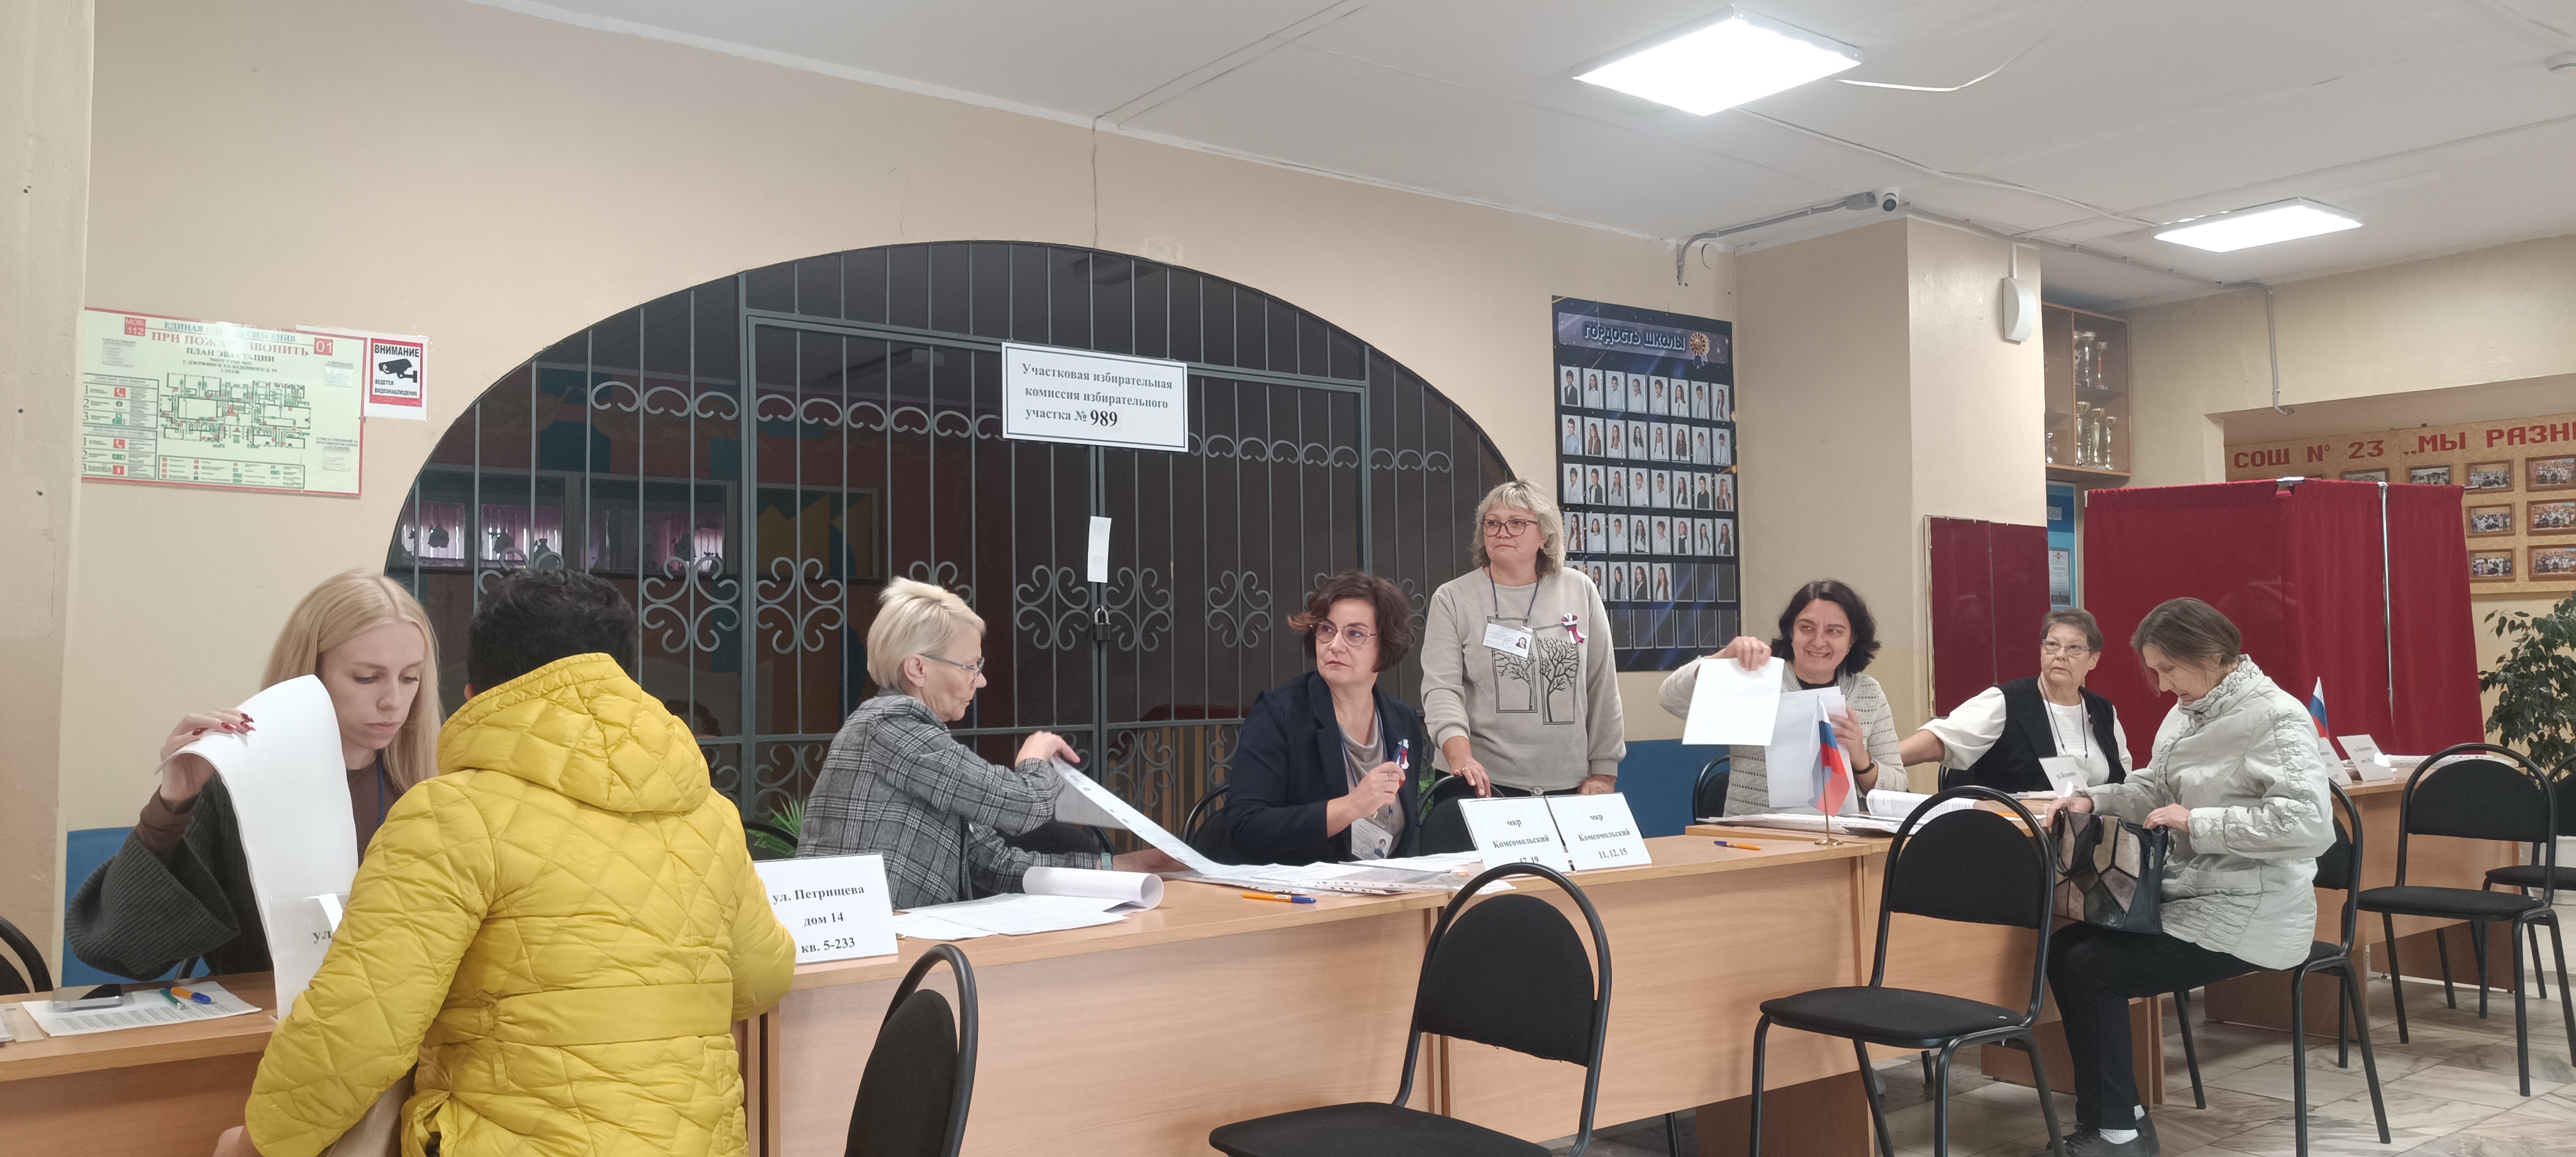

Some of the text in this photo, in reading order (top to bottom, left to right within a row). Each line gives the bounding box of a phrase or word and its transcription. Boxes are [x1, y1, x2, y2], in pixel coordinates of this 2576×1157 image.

[126, 318, 144, 326] МОБ
[128, 326, 144, 335] 112
[164, 321, 203, 333] ЕДИНАЯ
[247, 331, 296, 342] СПАСЕНИЯ
[1584, 324, 1685, 350] ГОРДОСТЬ ШКОЛЫ
[152, 332, 180, 343] ПРИ
[249, 341, 309, 356] ЗВОНИТЬ
[316, 340, 332, 353] 01
[374, 344, 419, 357] ВНИМАНИЕ
[186, 347, 214, 357] ПЛАН
[1021, 363, 1172, 389] Участковая избирательная
[374, 388, 418, 396] ВИДЕОНАБЛЮДЕНИЕ
[1025, 387, 1169, 409] комиссия избирательного
[1025, 408, 1118, 427] участка № 989
[2234, 448, 2290, 468] СОШ
[2348, 440, 2384, 459] 23
[1507, 819, 1521, 827] мкр
[1590, 813, 1603, 822] мкр
[1492, 834, 1550, 849] Комсомольский
[1577, 828, 1631, 842] Комсомольский
[1620, 848, 1628, 856] 15
[772, 886, 865, 905] ул. Петрищева
[804, 912, 844, 927] дом 14
[801, 937, 855, 953] кв. 5-233
